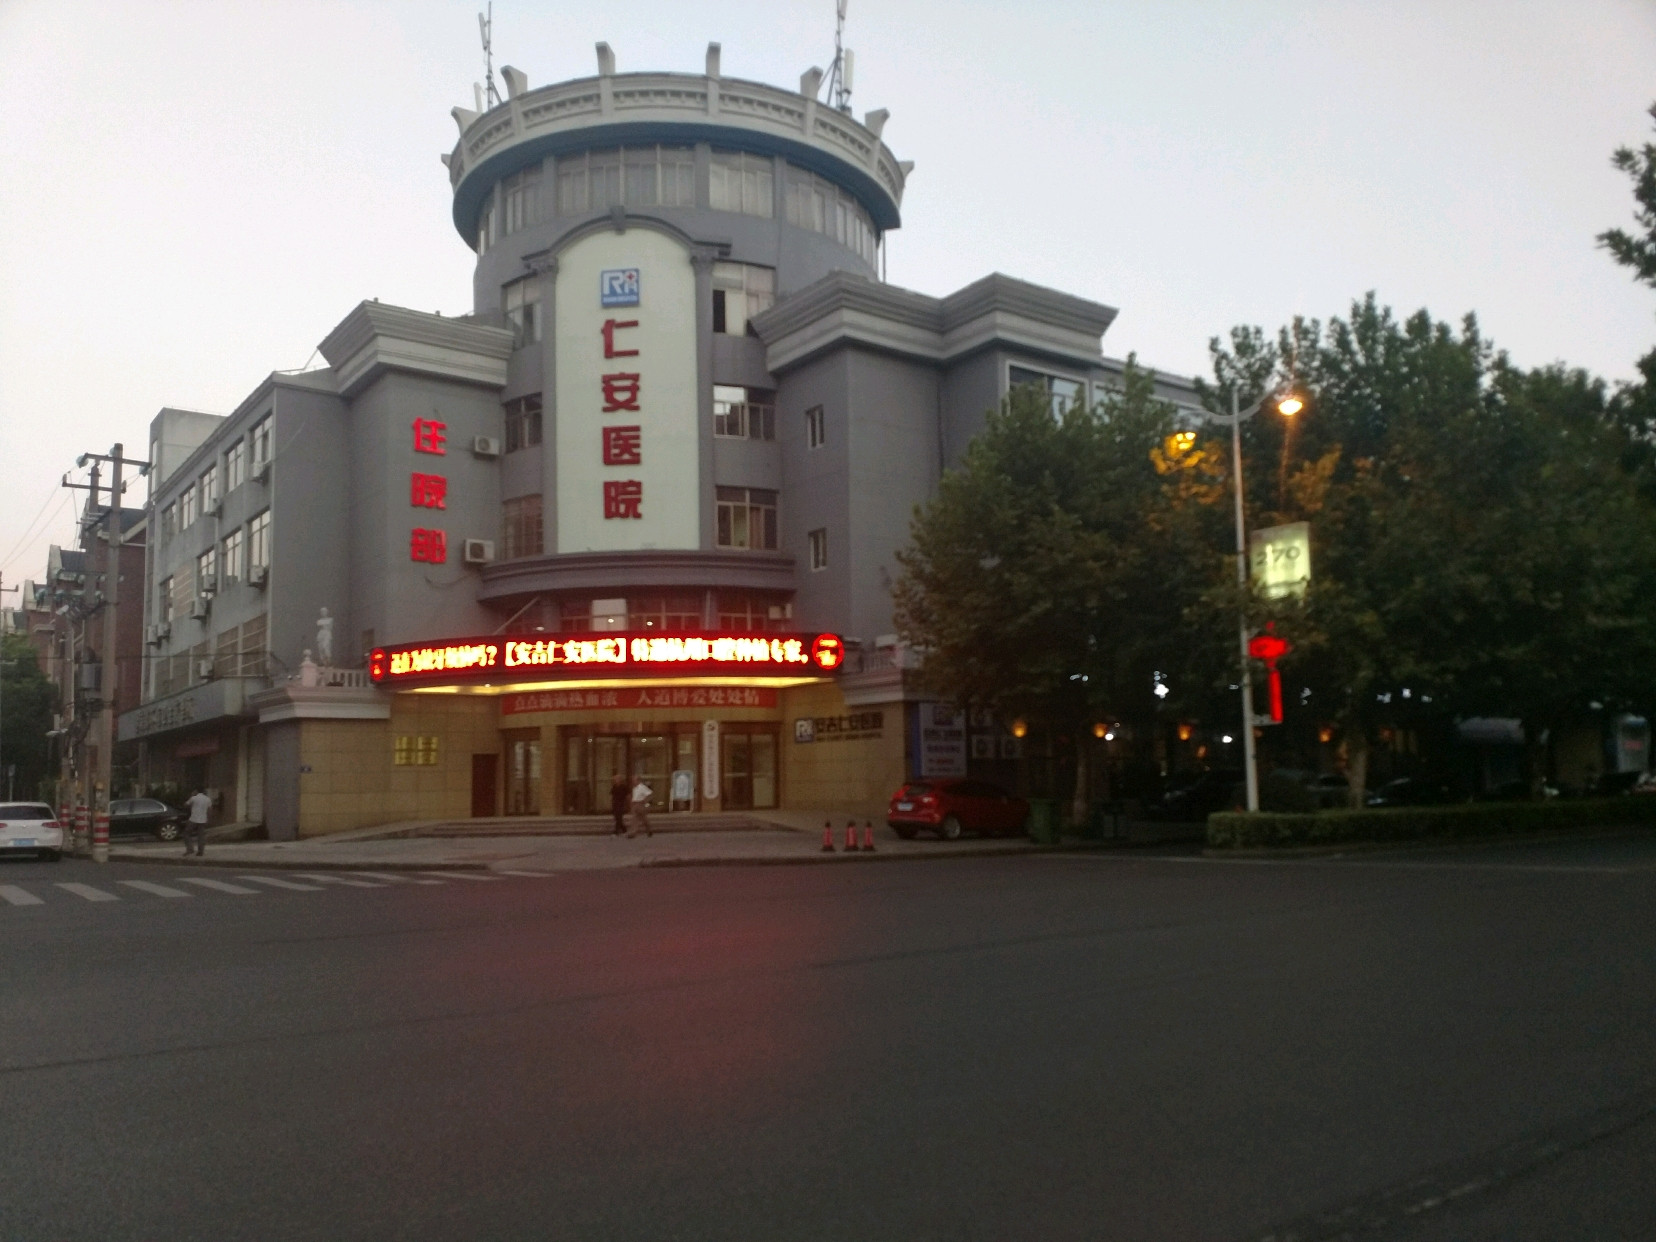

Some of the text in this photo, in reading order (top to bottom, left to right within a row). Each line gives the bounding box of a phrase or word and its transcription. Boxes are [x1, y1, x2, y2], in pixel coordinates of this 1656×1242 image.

[410, 417, 447, 563] 住院部
[602, 320, 642, 519] 仁安医院
